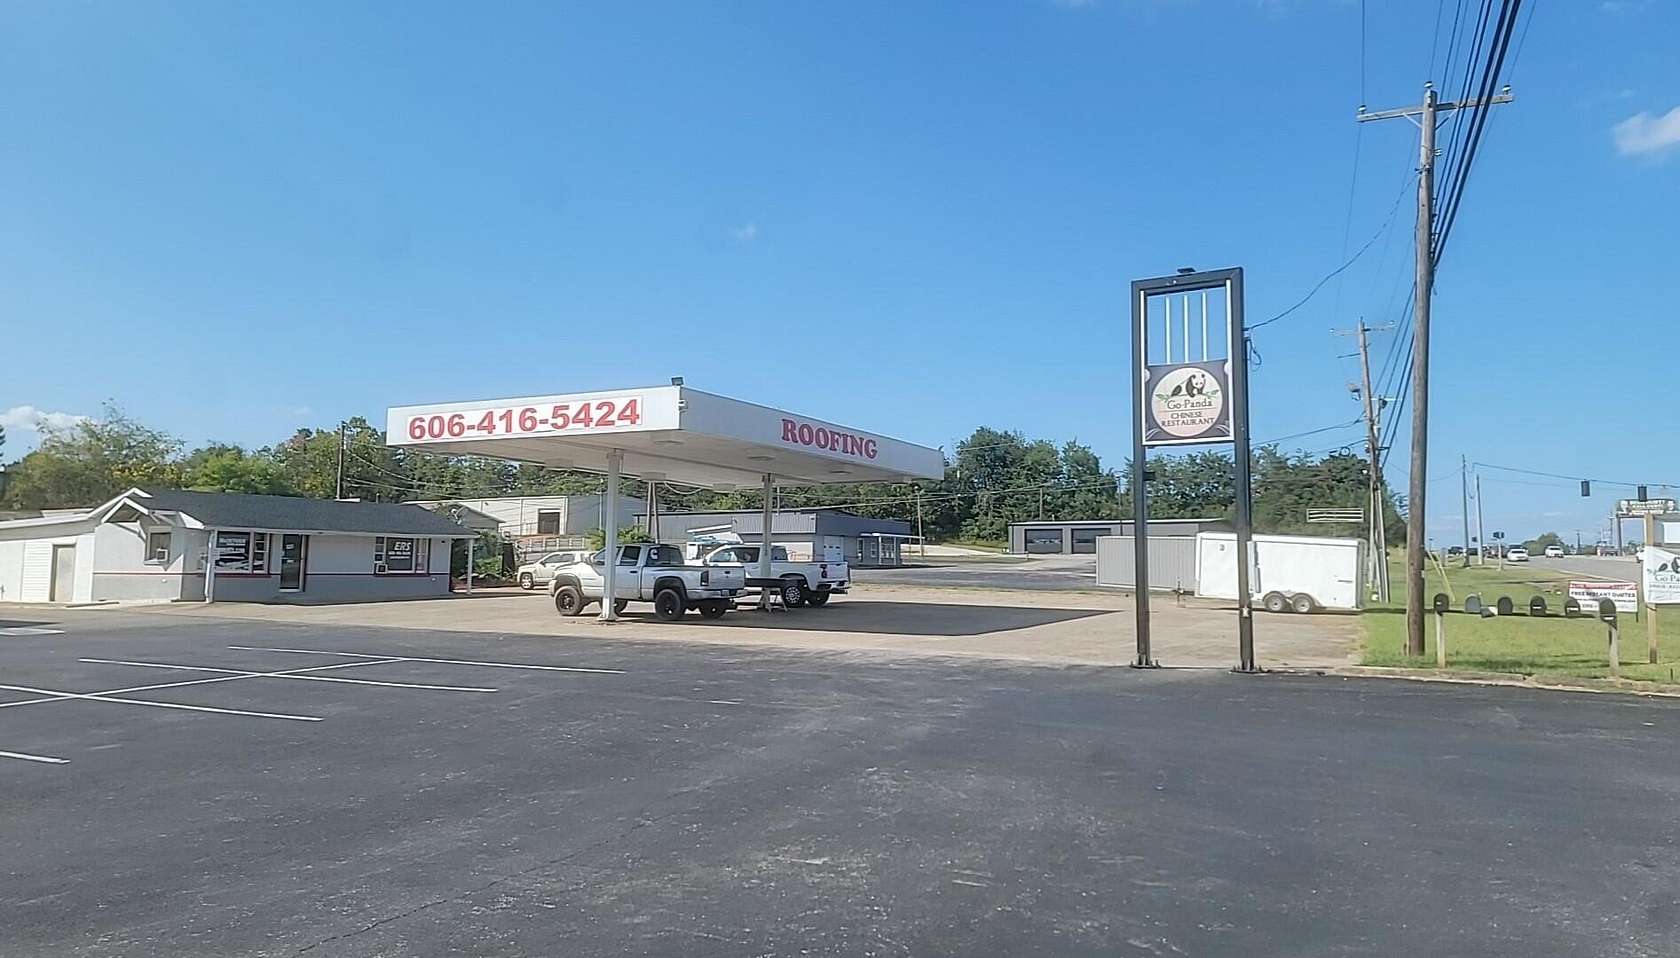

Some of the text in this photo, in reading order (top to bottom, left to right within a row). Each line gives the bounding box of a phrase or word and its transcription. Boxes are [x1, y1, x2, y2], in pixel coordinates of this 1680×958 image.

[409, 399, 640, 440] 606-416-5424
[1170, 411, 1203, 419] CHINESE
[1161, 418, 1215, 427] RESTAURANT
[781, 418, 878, 459] ROOFING
[394, 541, 411, 551] ERS
